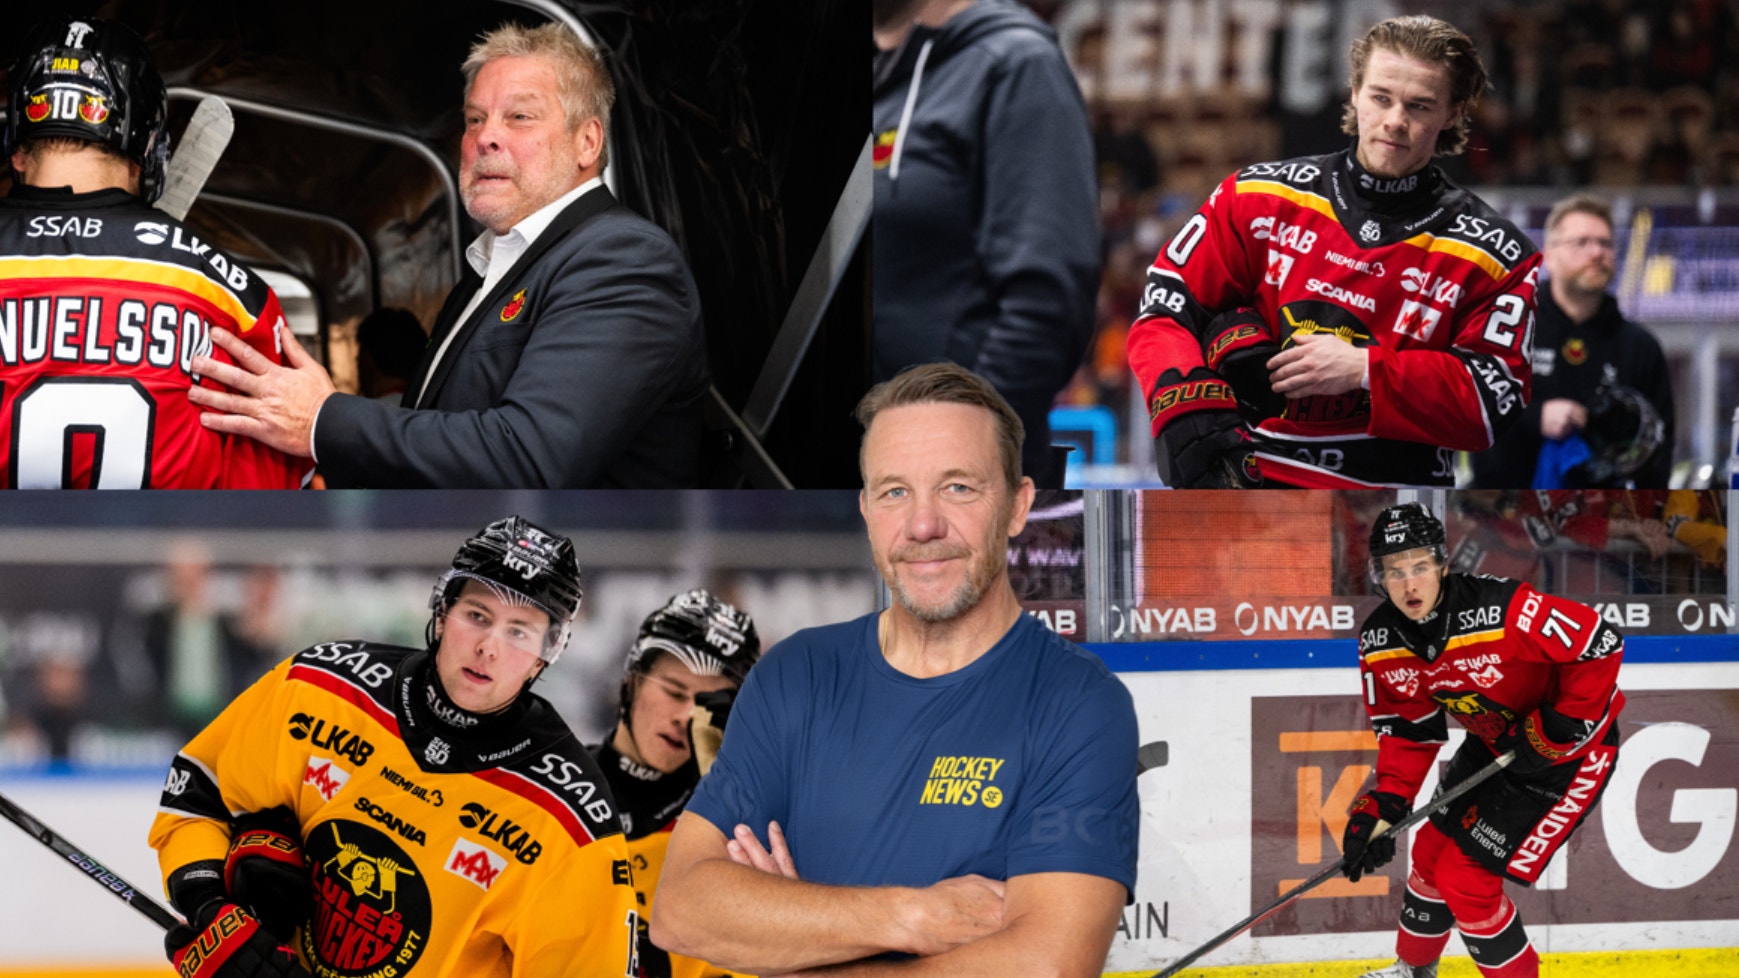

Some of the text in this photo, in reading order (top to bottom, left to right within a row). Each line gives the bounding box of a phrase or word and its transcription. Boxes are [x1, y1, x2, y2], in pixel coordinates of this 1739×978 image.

[52, 88, 81, 119] 10
[1241, 162, 1321, 184] SSAB
[1375, 175, 1418, 193] LKAB
[26, 215, 103, 238] SSAB
[1267, 218, 1319, 255] LKAB
[1447, 213, 1523, 262] SSAB
[171, 227, 249, 291] LKAB
[1324, 250, 1355, 269] NIEMI
[1305, 278, 1377, 314] SCANIA
[1420, 271, 1466, 309] LKA
[1384, 532, 1406, 544] kry
[503, 550, 541, 580] kry
[1129, 606, 1218, 634] NYAB
[1262, 605, 1355, 632] NYAB
[1458, 605, 1502, 631] SSAB
[1540, 607, 1582, 650] 71
[705, 628, 740, 656] kry
[301, 641, 394, 689] SSAB
[1466, 653, 1502, 671] LKAB
[310, 718, 376, 768] LKAB
[379, 765, 414, 793] NIEMI
[928, 756, 1005, 782] HOCKEY
[528, 752, 613, 824] SSAB
[919, 778, 982, 807] NEWS
[353, 796, 427, 848] SCANIA
[477, 812, 544, 866] LKAB
[449, 850, 500, 890] MAX
[395, 929, 421, 965] 1977
